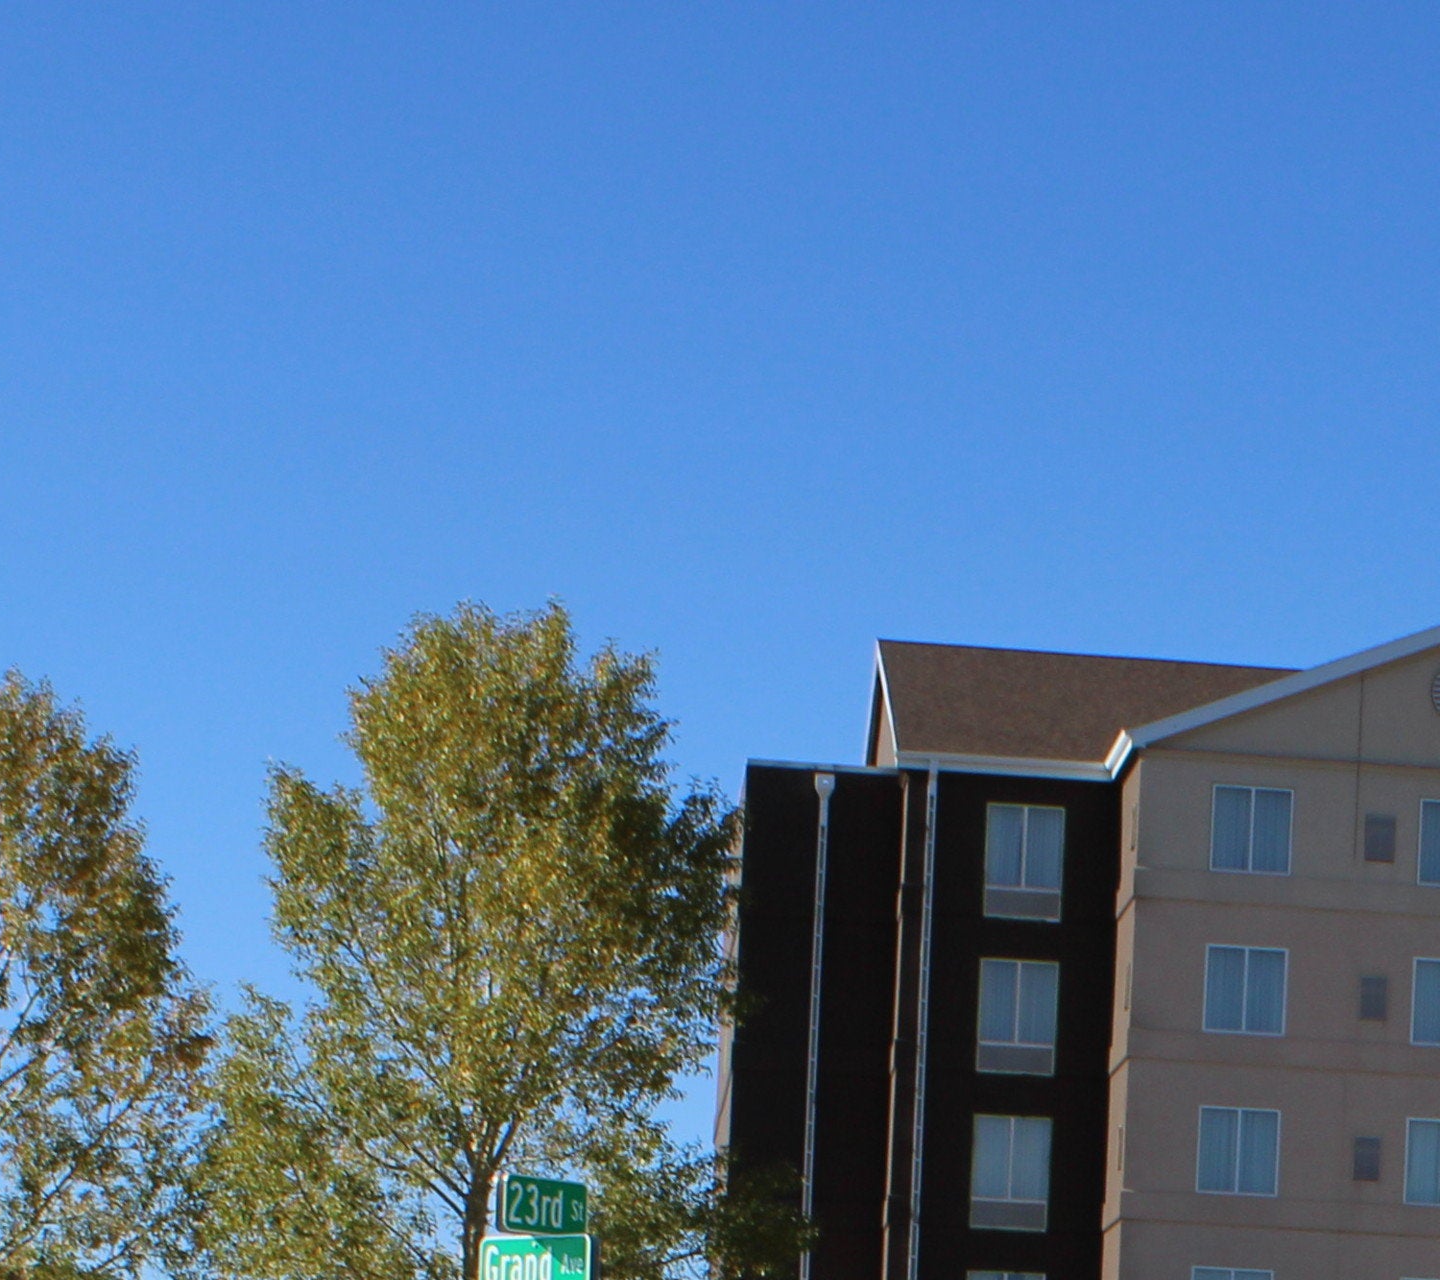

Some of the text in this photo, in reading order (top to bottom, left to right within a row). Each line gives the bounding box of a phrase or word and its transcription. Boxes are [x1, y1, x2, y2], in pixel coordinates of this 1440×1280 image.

[509, 1181, 583, 1227] 23rd St
[561, 1255, 584, 1275] Ave
